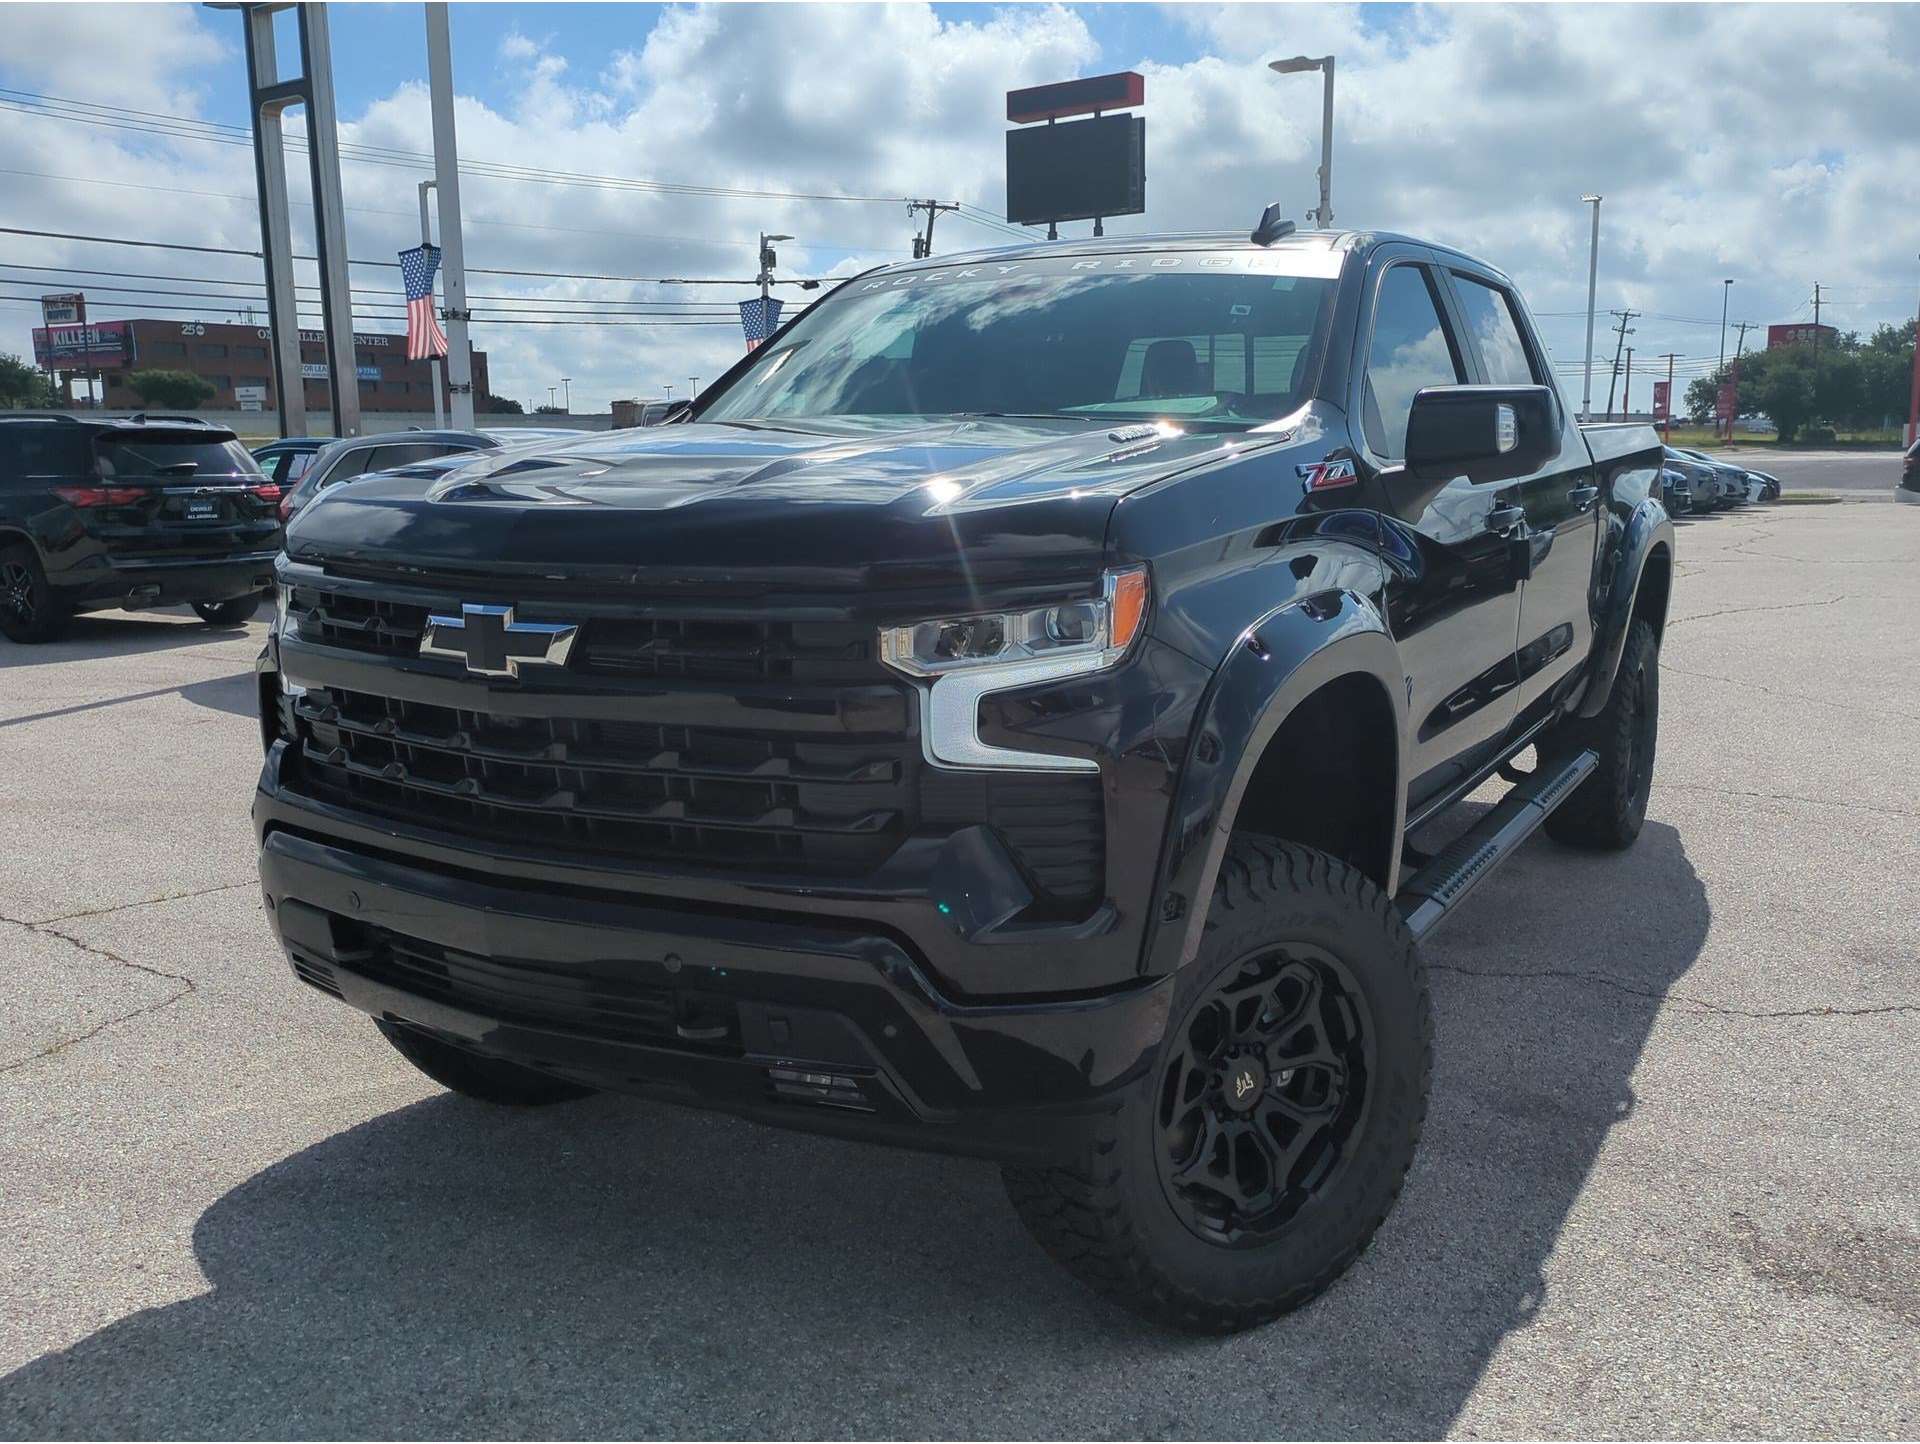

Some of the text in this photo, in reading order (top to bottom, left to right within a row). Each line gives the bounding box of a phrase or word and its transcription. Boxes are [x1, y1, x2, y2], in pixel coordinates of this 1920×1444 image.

[861, 264, 1023, 292] ROCKY
[52, 327, 101, 346] KILLEEN
[352, 334, 389, 347] ENTER
